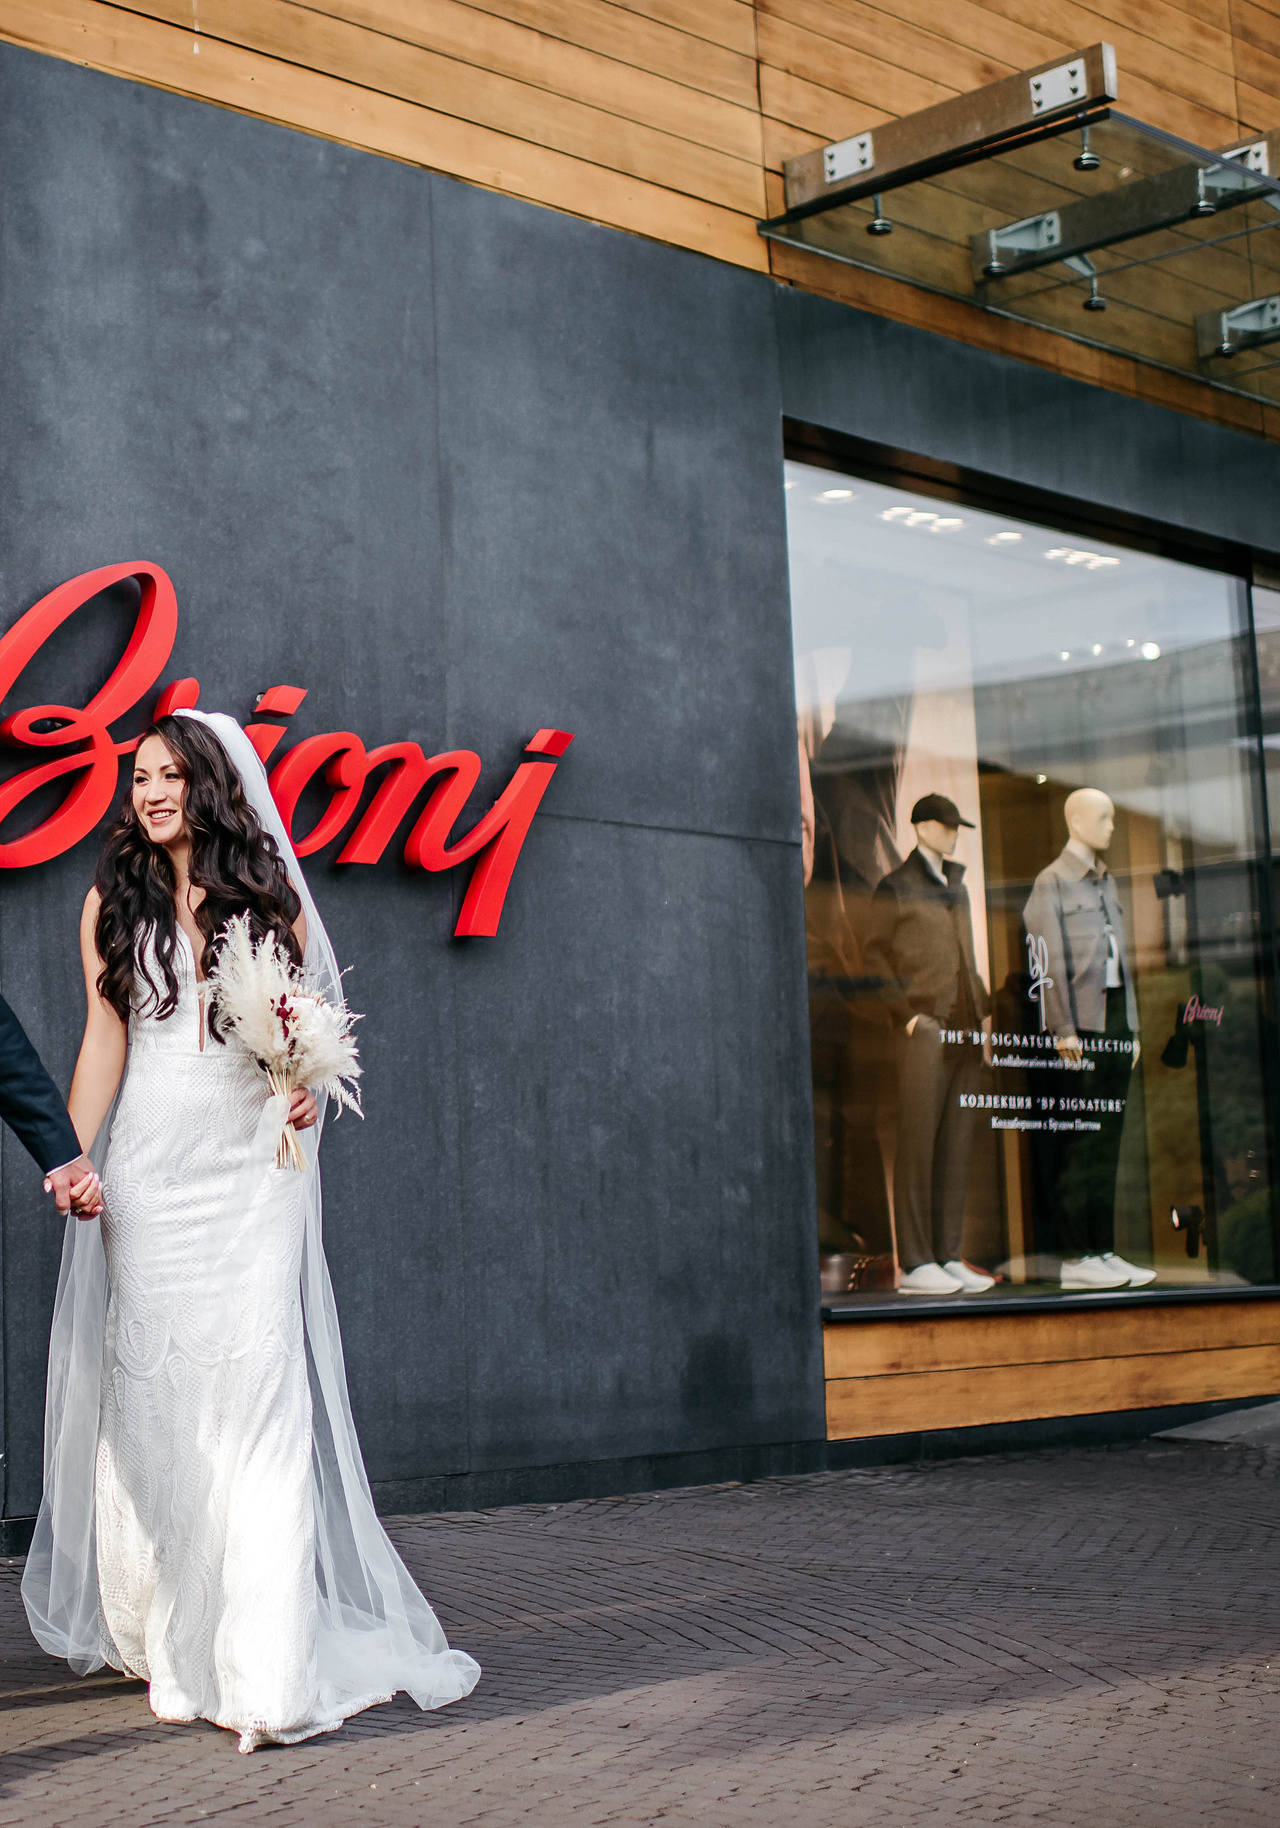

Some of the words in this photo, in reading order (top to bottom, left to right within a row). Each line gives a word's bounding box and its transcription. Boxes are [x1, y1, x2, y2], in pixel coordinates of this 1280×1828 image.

[939, 1029, 964, 1045] THE
[1066, 1037, 1140, 1054] OLLECTION
[959, 1093, 1032, 1111] КОЛЛЕКЦИЯ
